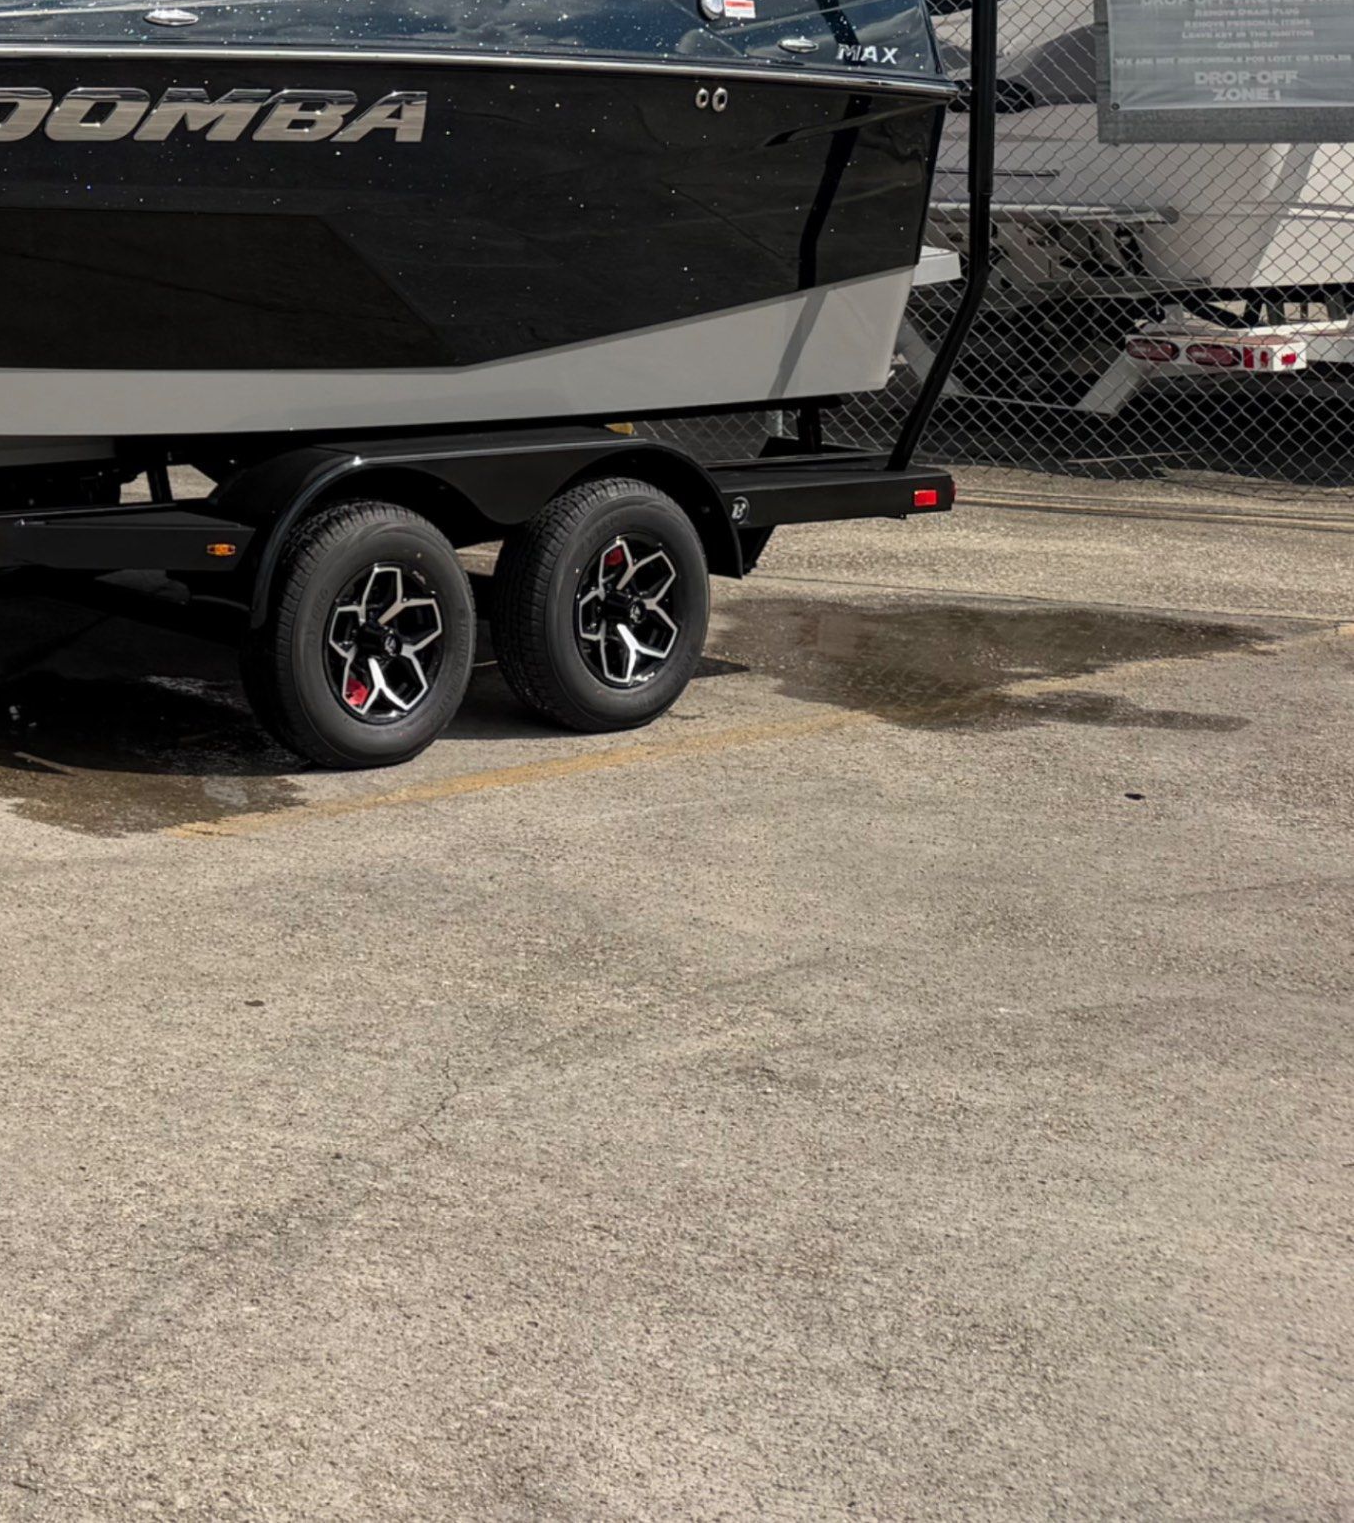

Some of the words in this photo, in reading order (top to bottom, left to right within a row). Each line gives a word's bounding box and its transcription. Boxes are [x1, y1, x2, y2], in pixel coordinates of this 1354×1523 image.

[836, 43, 901, 65] MAX
[1194, 71, 1249, 85] DROP
[1256, 70, 1298, 84] OFF
[1213, 87, 1270, 101] ZONE
[1273, 89, 1281, 101] 1
